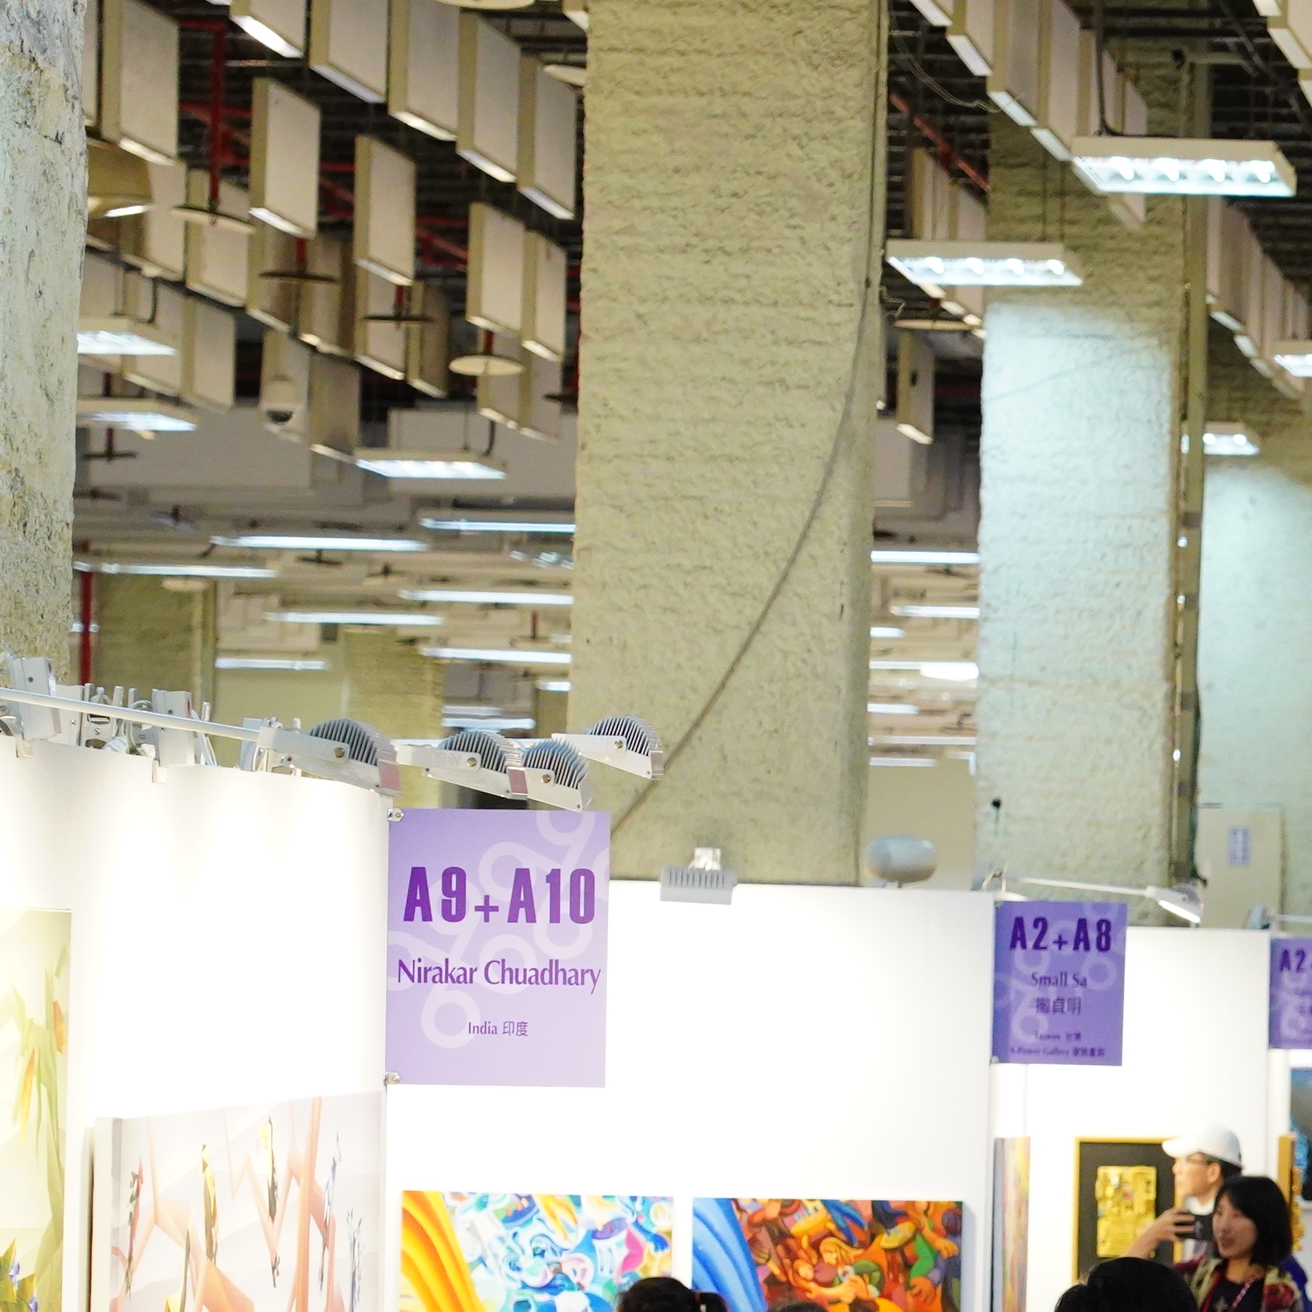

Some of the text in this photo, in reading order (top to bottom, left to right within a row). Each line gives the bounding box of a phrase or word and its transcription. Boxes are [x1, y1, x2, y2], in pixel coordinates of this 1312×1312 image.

[403, 866, 596, 925] A9+A10
[1009, 915, 1112, 952] A2+A8
[397, 957, 602, 995] Nirakar Chuadhary
[1031, 970, 1068, 987] Small
[468, 1020, 529, 1037] India 印度
